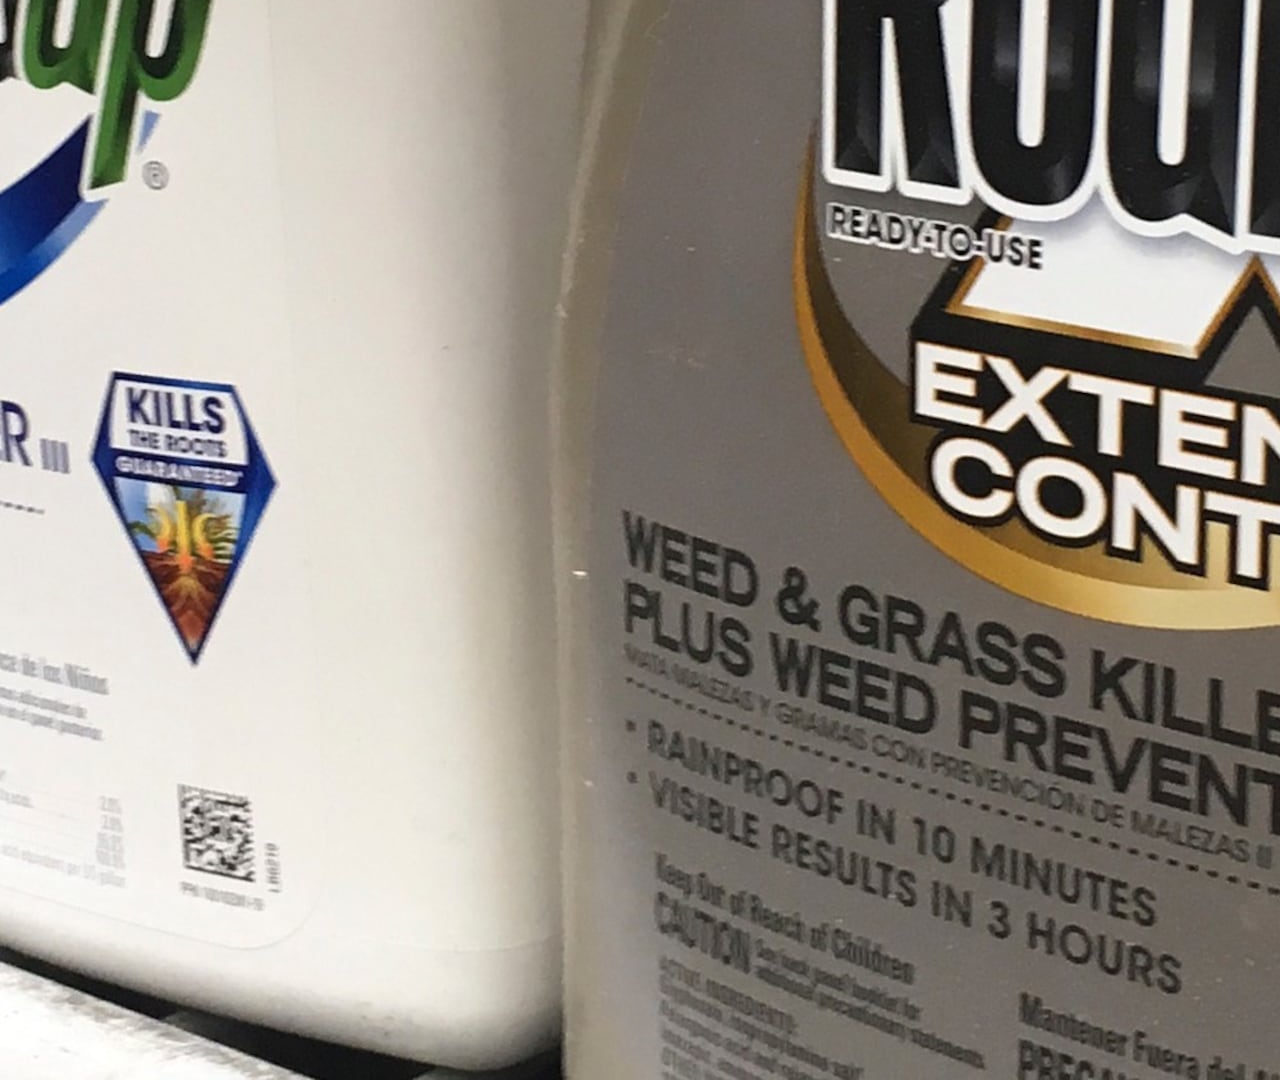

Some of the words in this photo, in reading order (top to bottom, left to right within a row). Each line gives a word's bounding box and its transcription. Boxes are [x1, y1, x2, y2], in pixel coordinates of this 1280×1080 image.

[825, 204, 1045, 271] READY-TO-USE
[39, 437, 71, 475] III
[126, 386, 226, 434] KILLS
[165, 433, 228, 458] ROOTS
[622, 509, 759, 609] WEED
[777, 565, 820, 633] &
[838, 584, 1068, 698] GRASS
[623, 577, 753, 679] PLUS
[769, 631, 938, 735] WEED
[647, 719, 844, 825] RAINPROOF
[856, 798, 896, 846] IN
[913, 816, 957, 864] 10
[970, 835, 1158, 929] MINUTES
[872, 733, 926, 770] CON
[1091, 797, 1125, 828] DE
[1130, 810, 1251, 864] MALEZAS
[647, 770, 760, 851] VISIBLE
[771, 823, 918, 909] RESULTS
[931, 879, 972, 929] IN
[988, 900, 1012, 940] 3
[1026, 910, 1183, 995] HOURS
[1019, 991, 1128, 1057] Mantener
